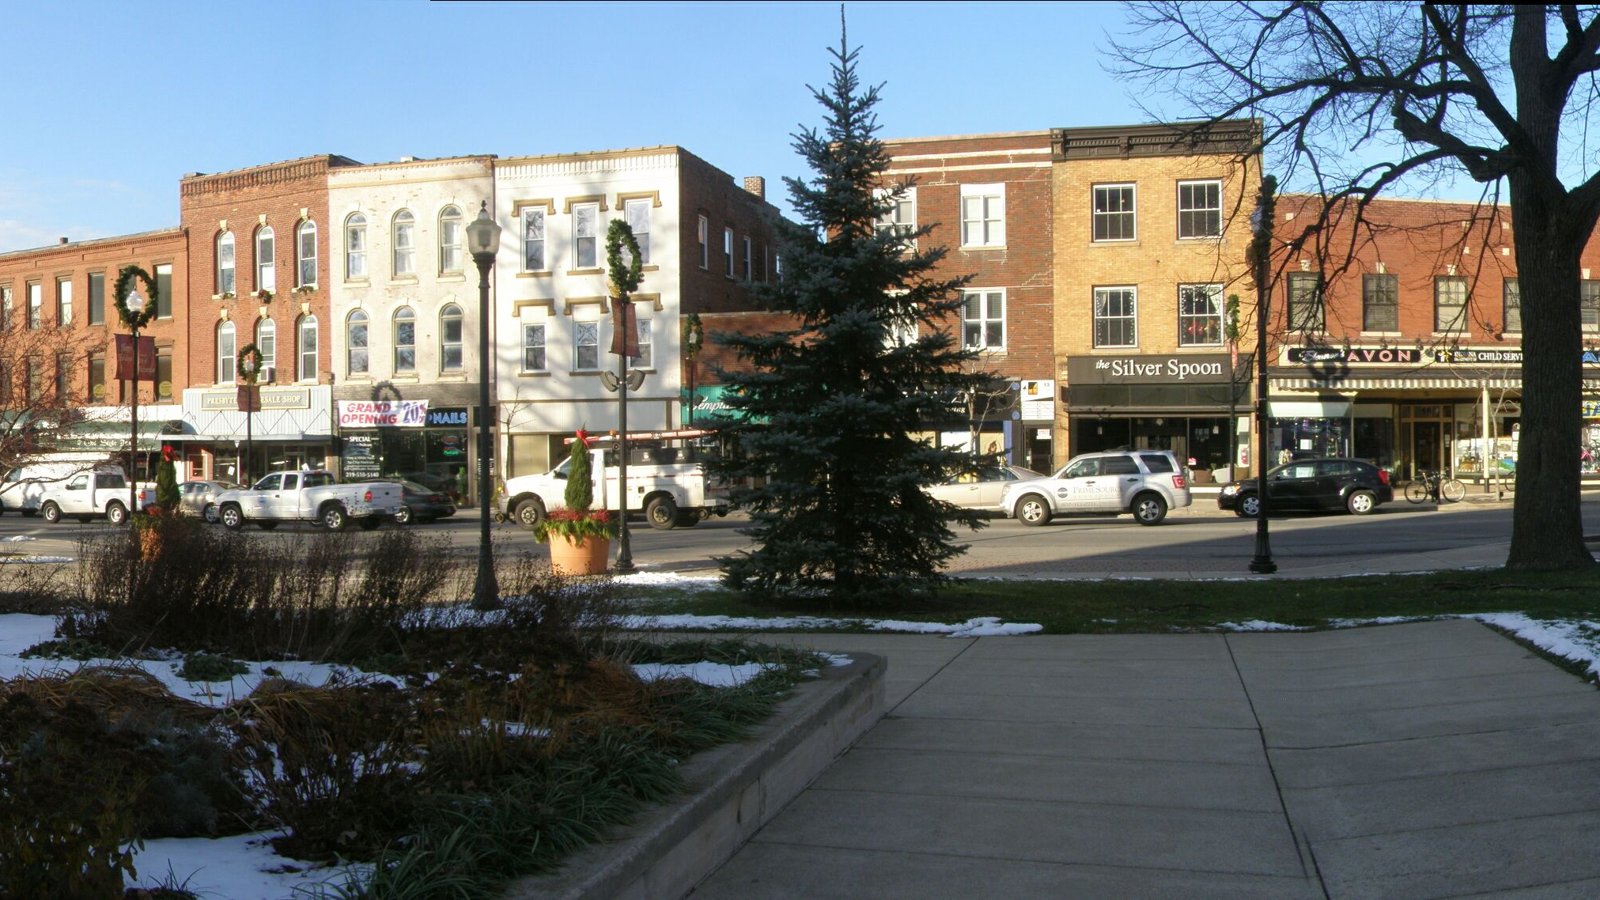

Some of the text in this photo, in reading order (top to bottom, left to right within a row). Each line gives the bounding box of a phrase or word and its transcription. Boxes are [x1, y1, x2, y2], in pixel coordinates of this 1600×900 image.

[1347, 350, 1411, 362] AVON
[1478, 352, 1502, 361] CHILD
[1503, 352, 1523, 361] SERVI
[1095, 359, 1222, 379] the Silver Spoon
[207, 394, 302, 405] PRESBYTE ESALE SHOP
[347, 403, 392, 413] GRAND
[341, 414, 398, 424] OPENING
[433, 411, 467, 424] NAILS
